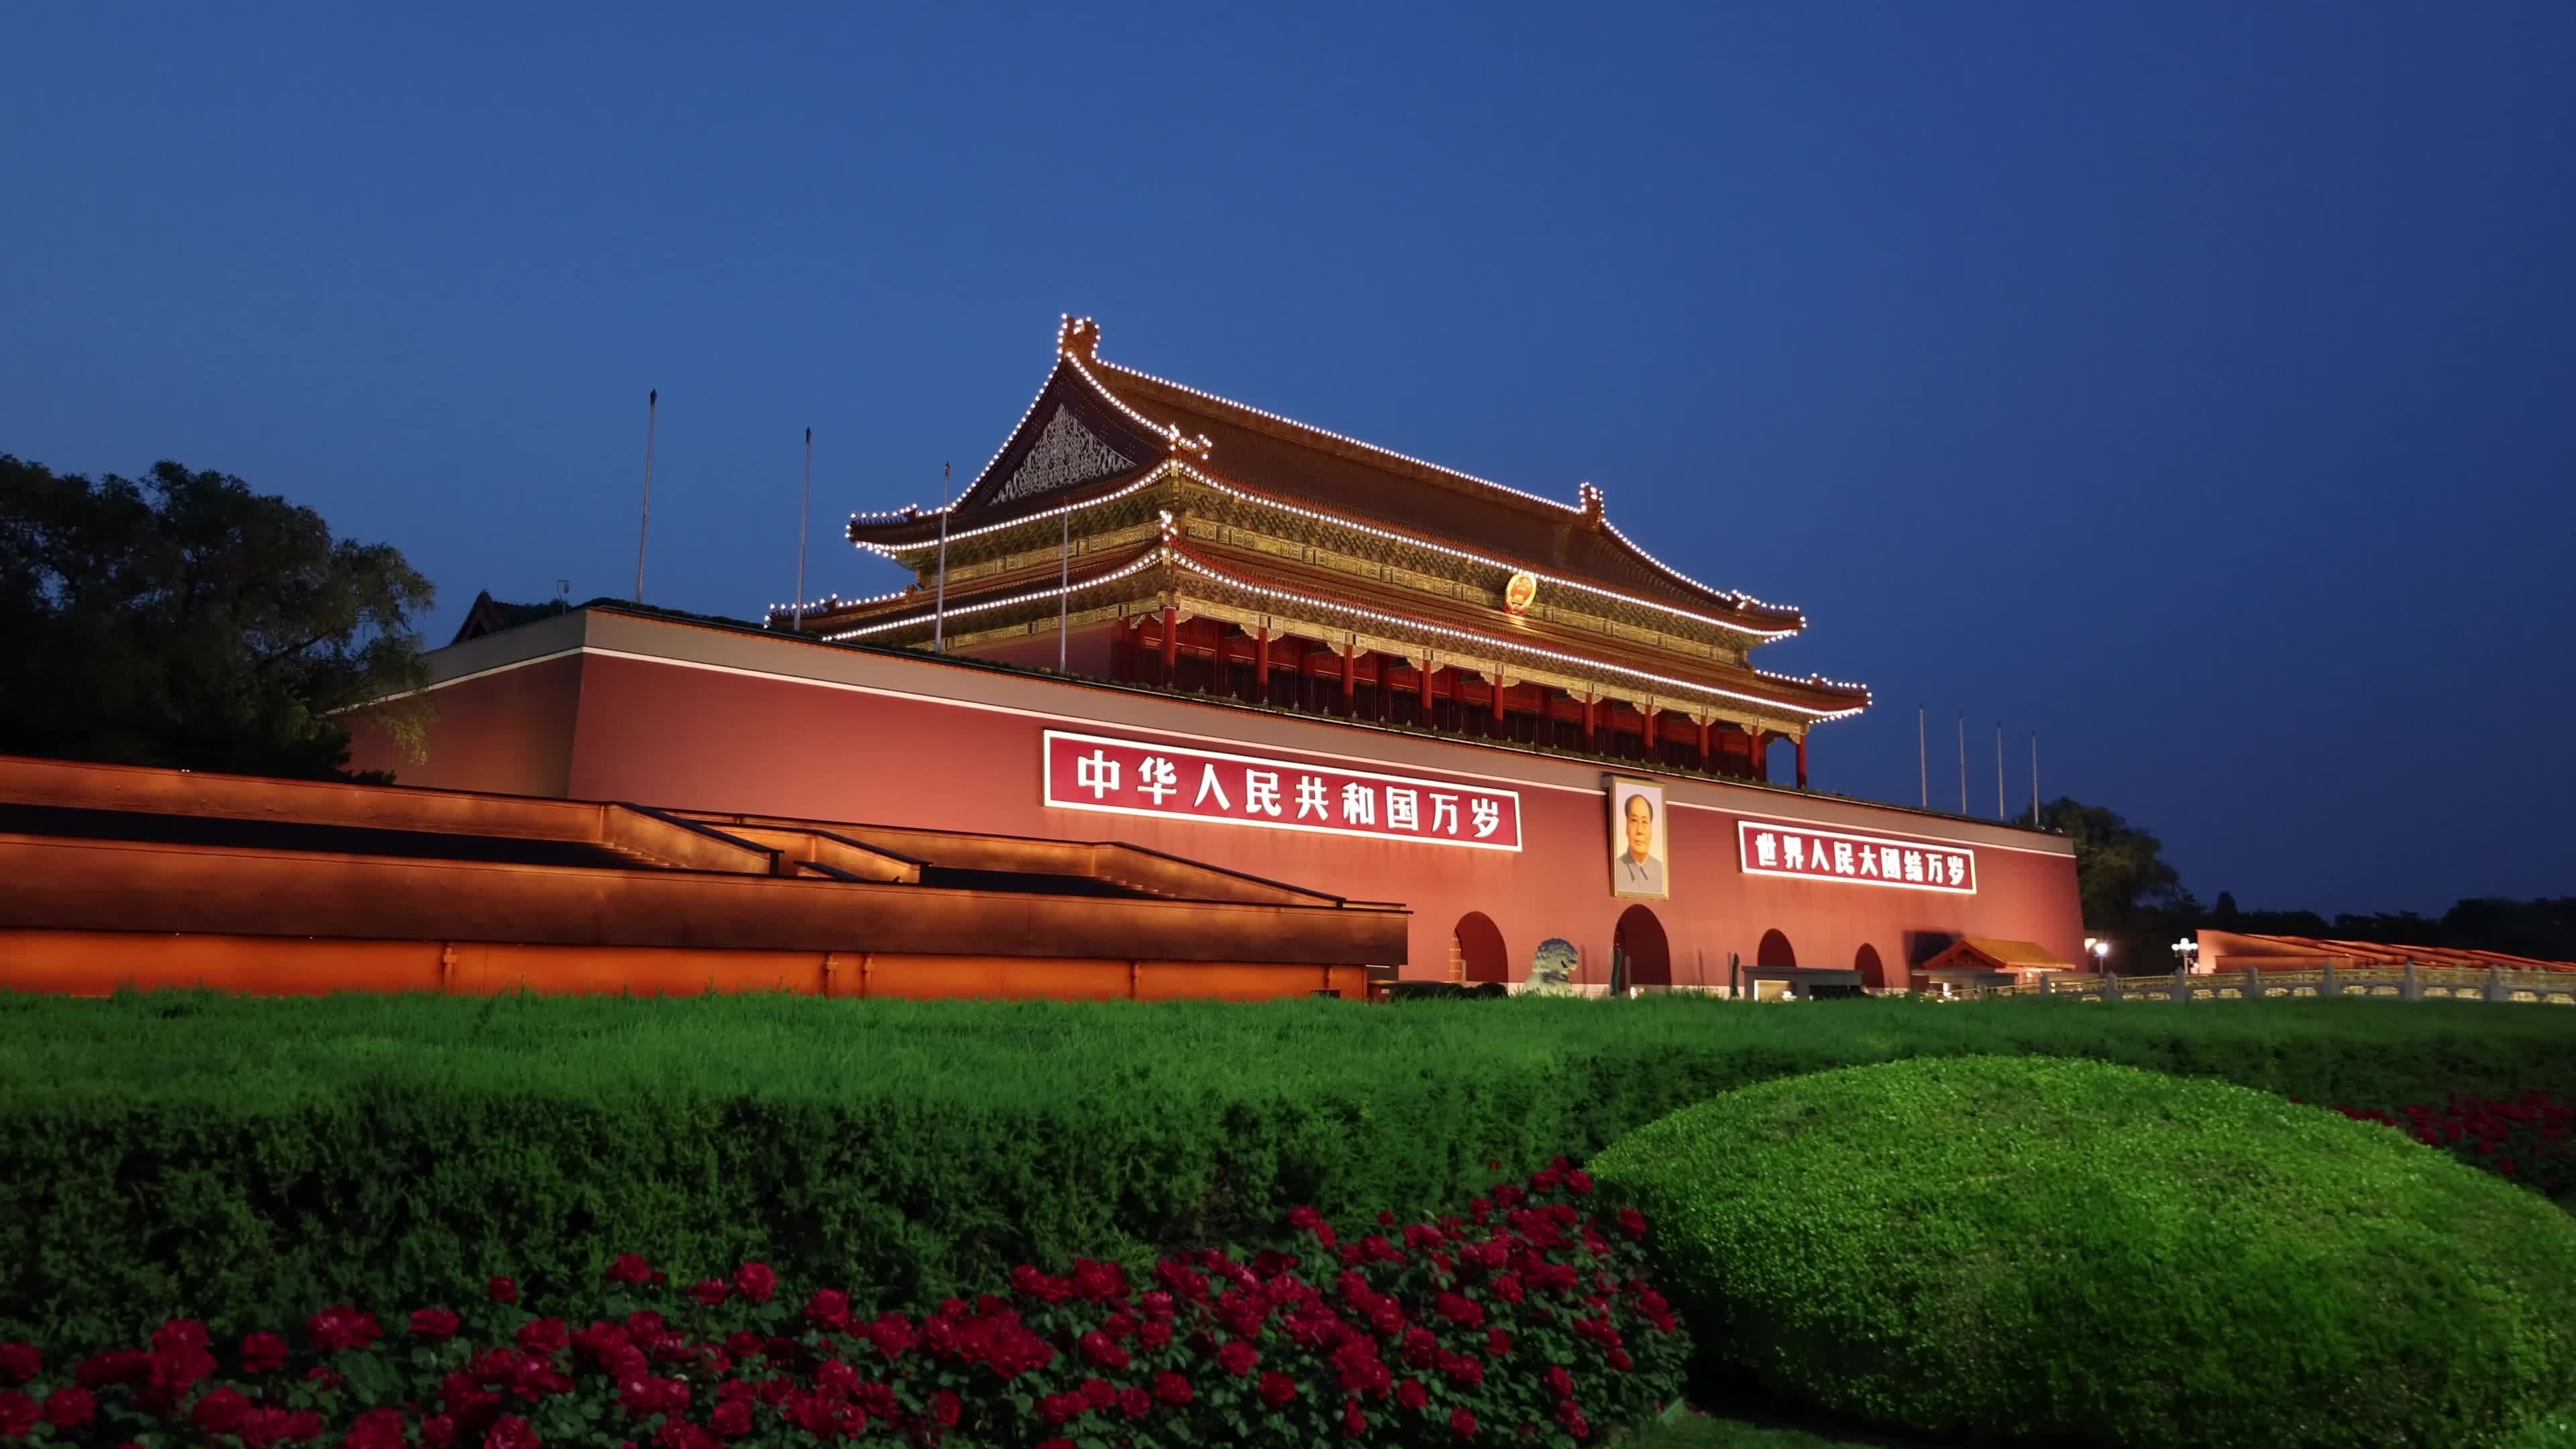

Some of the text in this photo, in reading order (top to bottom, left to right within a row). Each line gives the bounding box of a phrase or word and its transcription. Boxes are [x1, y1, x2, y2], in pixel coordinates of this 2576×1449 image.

[1077, 749, 1500, 839] 中华人民共和国万岁
[1755, 833, 1966, 886] 世界人民大团结万岁
